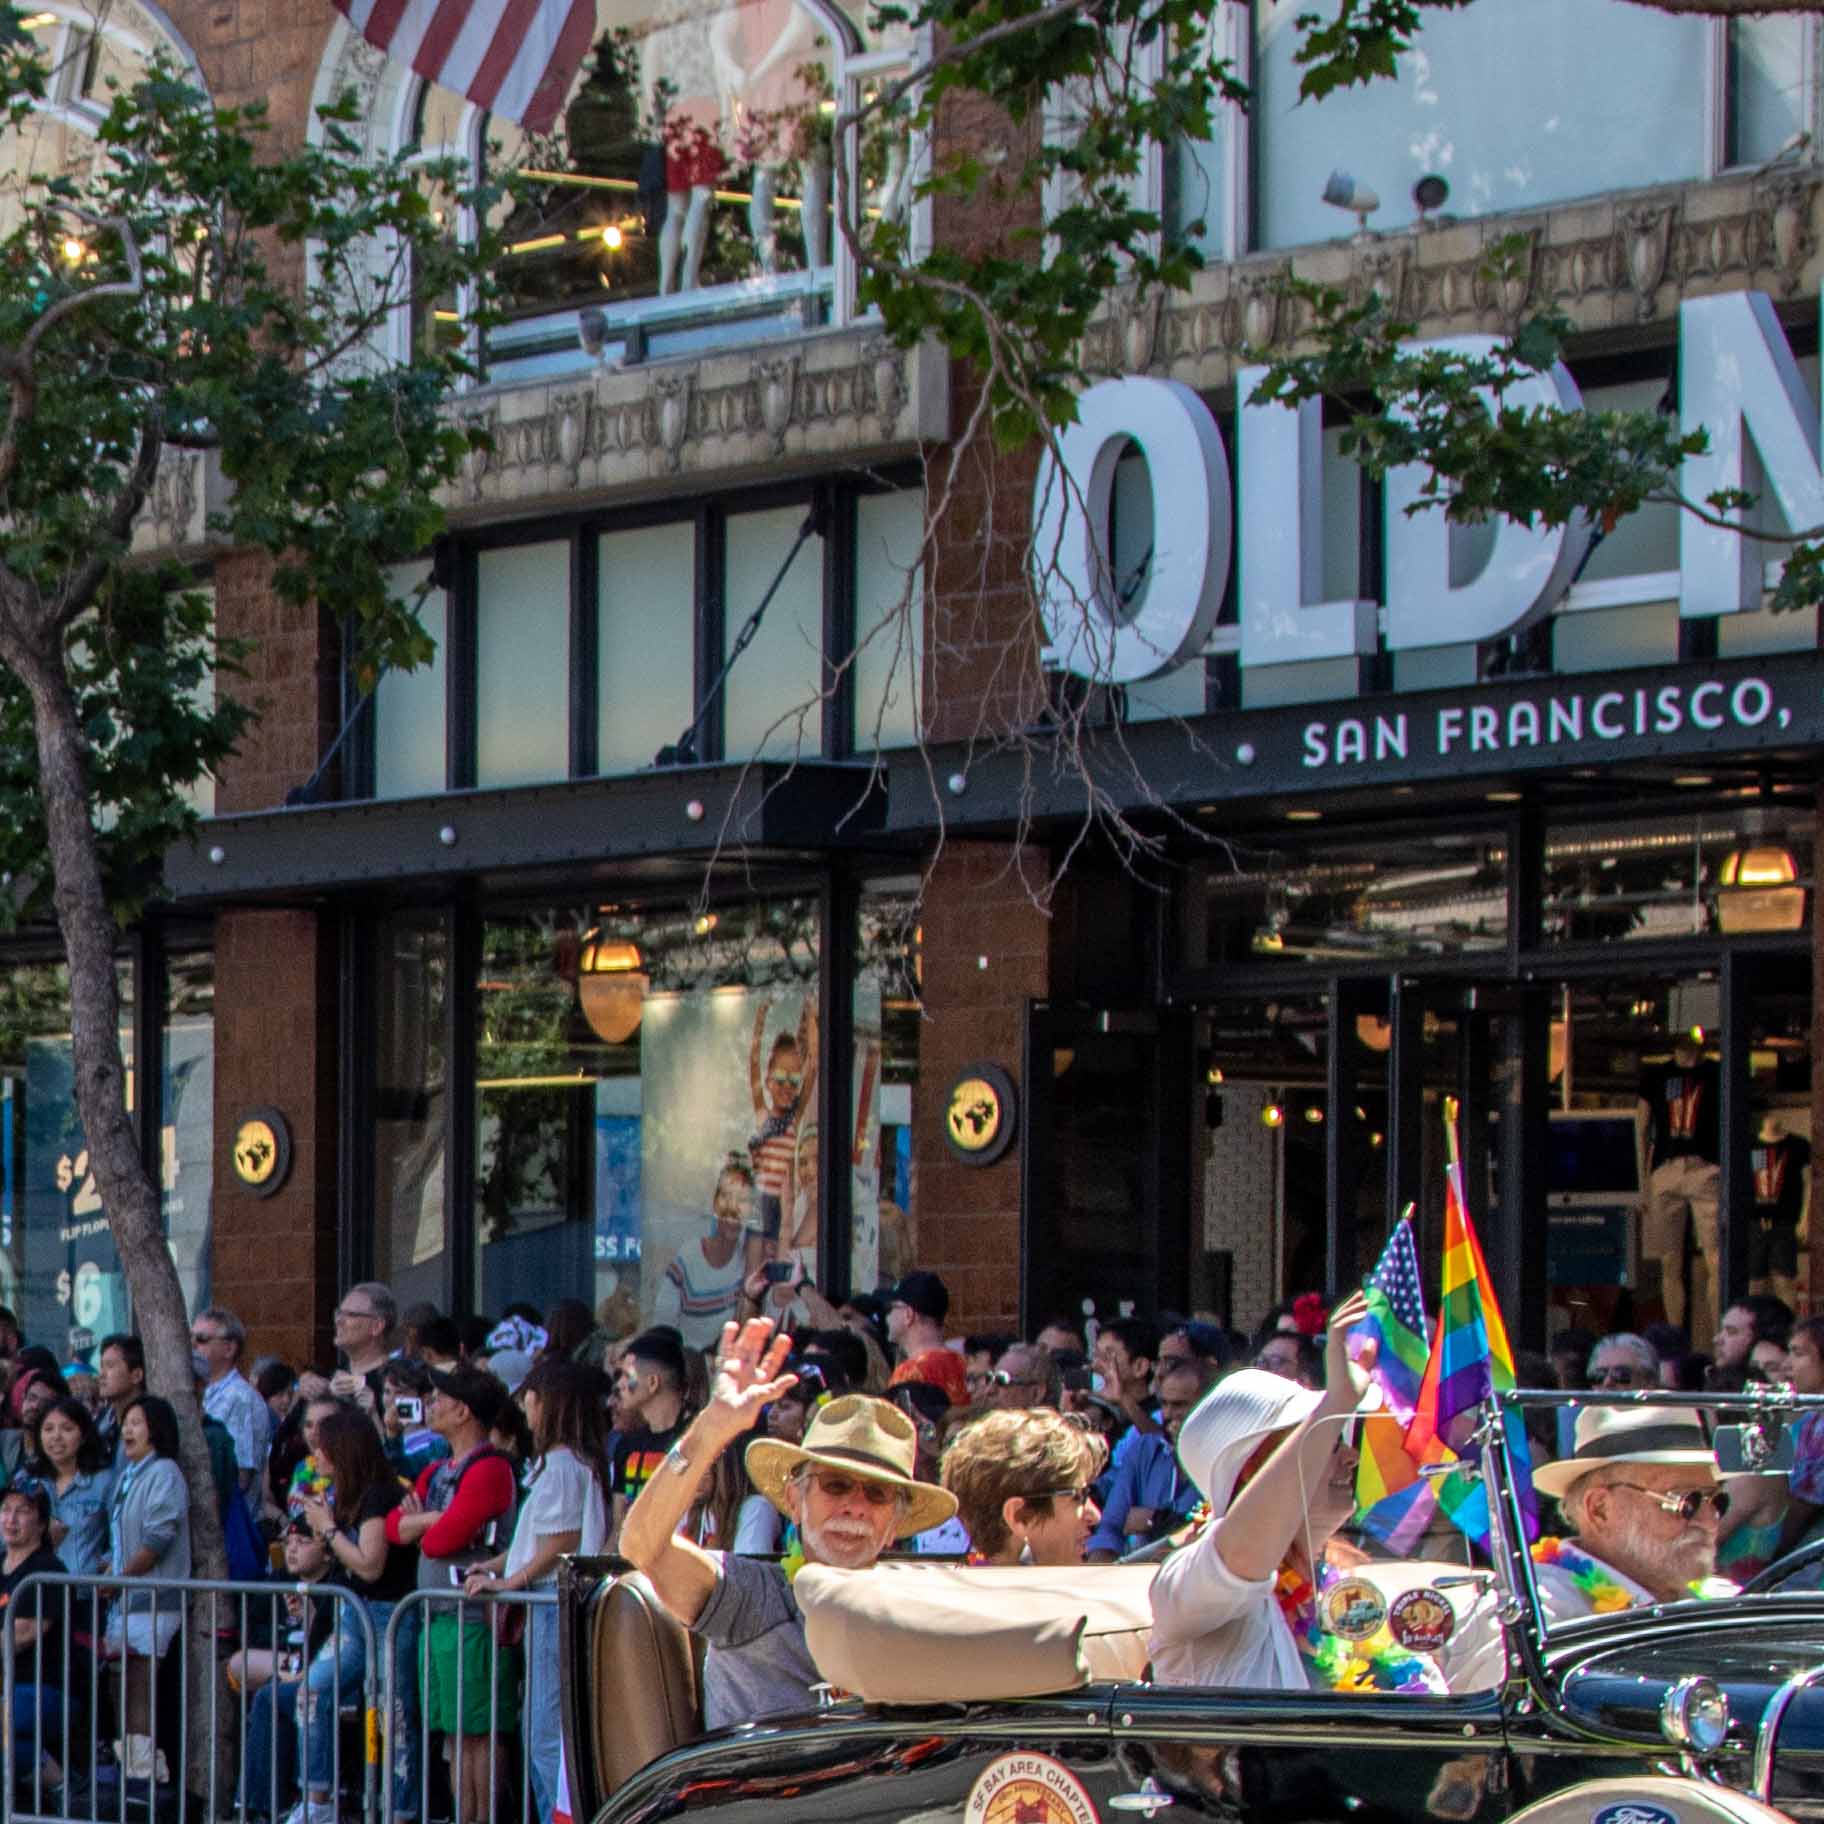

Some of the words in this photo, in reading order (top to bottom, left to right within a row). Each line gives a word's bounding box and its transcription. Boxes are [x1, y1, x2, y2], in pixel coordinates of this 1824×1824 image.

[1036, 334, 1590, 682] OLD
[1302, 720, 1408, 768] SAN
[1437, 677, 1792, 754] FRANCISCO,
[972, 1792, 985, 1813] SF
[983, 1769, 1006, 1794] BAY
[1009, 1761, 1042, 1776] AREA
